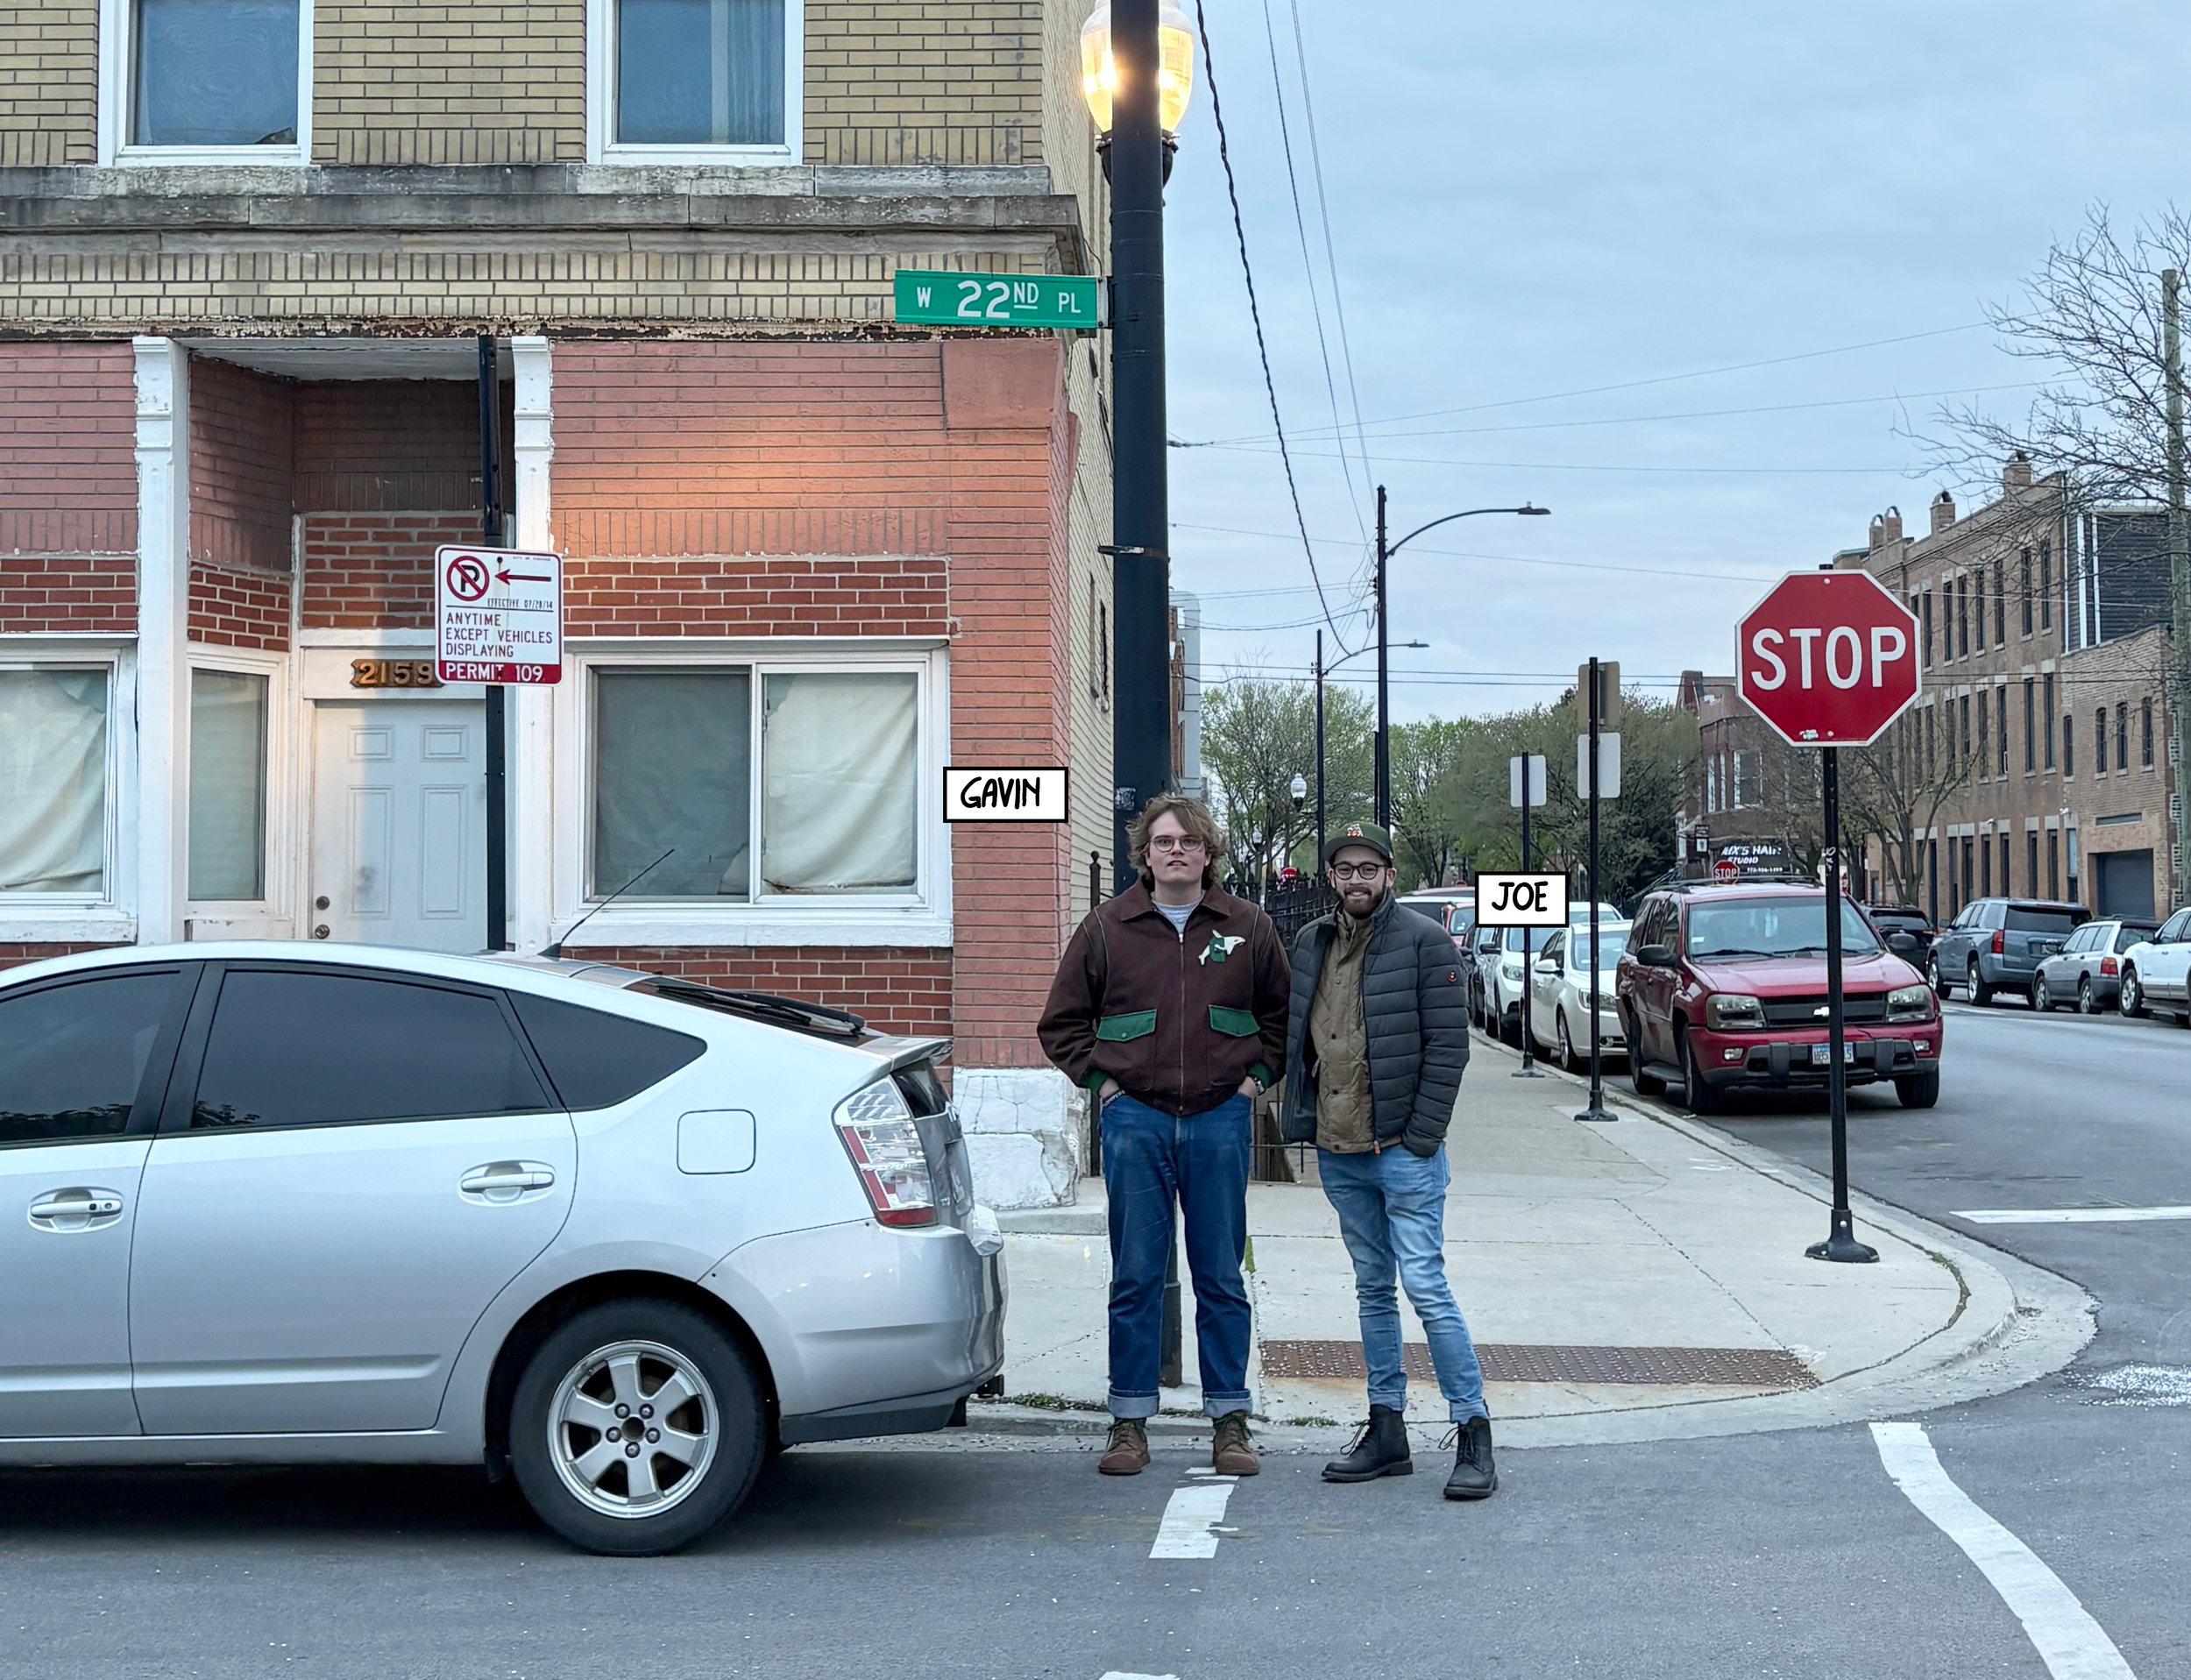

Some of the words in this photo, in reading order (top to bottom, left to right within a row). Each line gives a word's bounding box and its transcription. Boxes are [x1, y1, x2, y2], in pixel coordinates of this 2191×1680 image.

[916, 287, 932, 308] W
[957, 280, 1039, 318] 22ND
[1058, 292, 1081, 314] PL
[487, 598, 520, 608] EFFECTIVE
[446, 612, 501, 627] ANYTIME
[446, 627, 489, 641] EXCEPT
[498, 629, 553, 644] VEHICLES
[446, 643, 514, 657] DISPLAYING
[1751, 626, 1906, 691] STOP
[358, 662, 433, 685] 2159
[445, 663, 504, 681] PERMIT
[515, 665, 543, 682] 109
[1714, 868, 1738, 879] STOP
